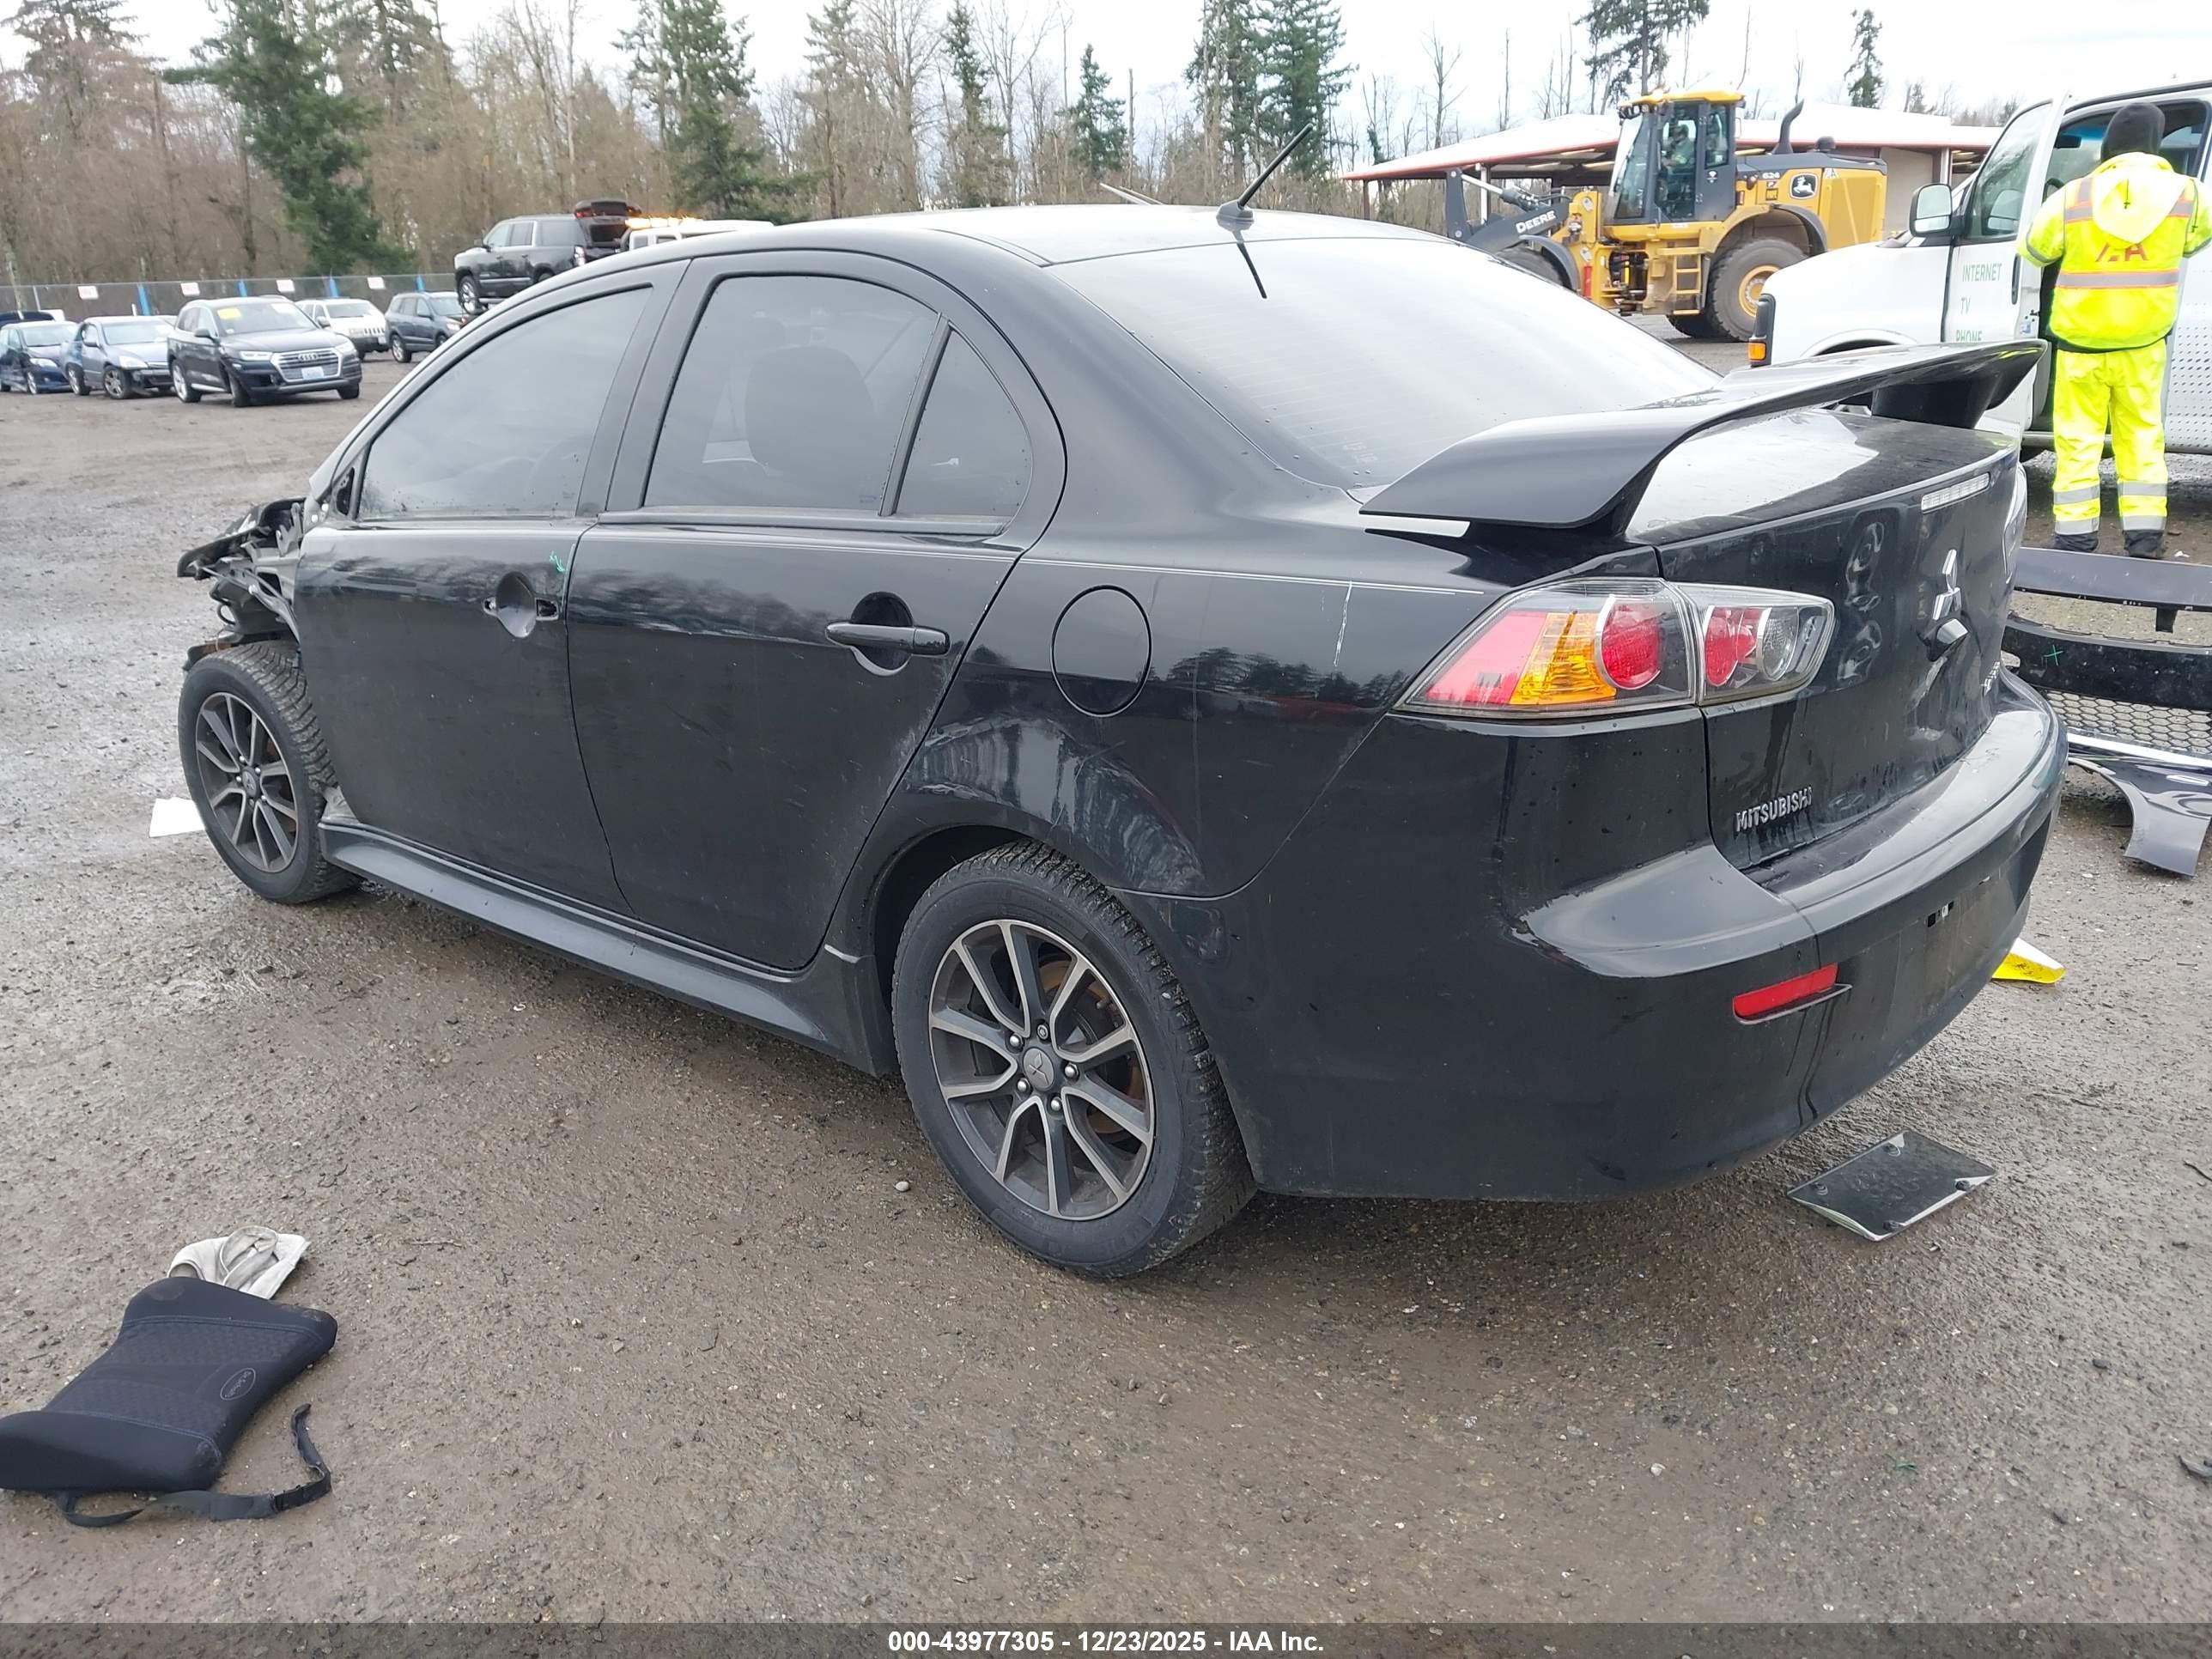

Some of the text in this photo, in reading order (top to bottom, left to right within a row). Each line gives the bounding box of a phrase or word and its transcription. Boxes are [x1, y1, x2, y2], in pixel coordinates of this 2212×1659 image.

[1516, 210, 1556, 234] DEERE
[1962, 263, 2002, 282] INTERNET
[1960, 297, 1971, 314] TV
[1735, 786, 1812, 832] MITSUBISHI
